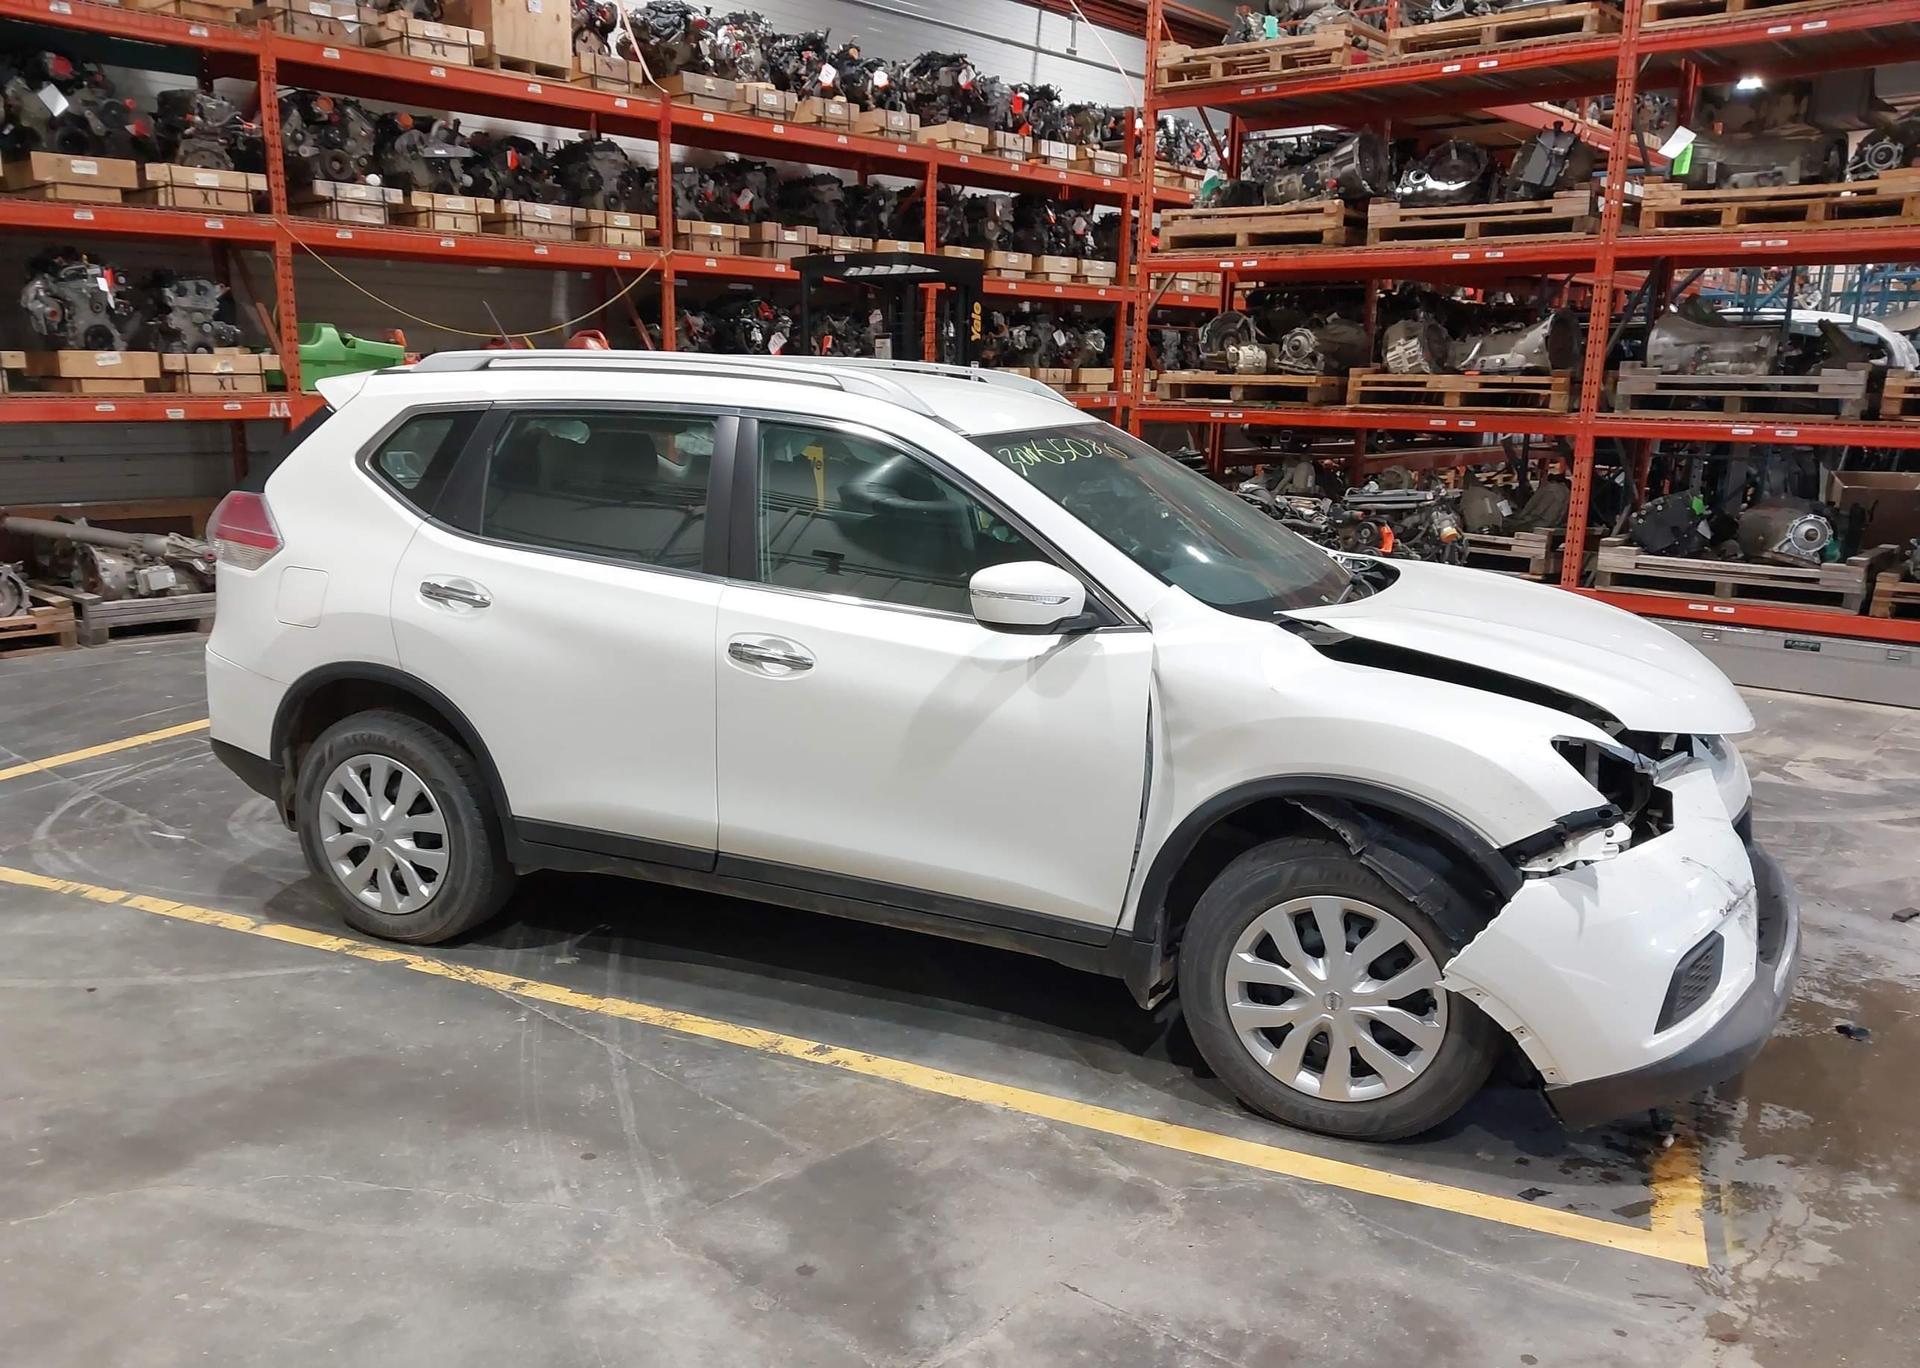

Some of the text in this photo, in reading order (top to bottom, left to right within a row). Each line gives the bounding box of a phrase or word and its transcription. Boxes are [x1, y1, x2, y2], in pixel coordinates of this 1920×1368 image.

[201, 190, 222, 206] XL
[971, 301, 982, 341] Yale
[217, 376, 238, 391] XL
[269, 399, 292, 418] AA
